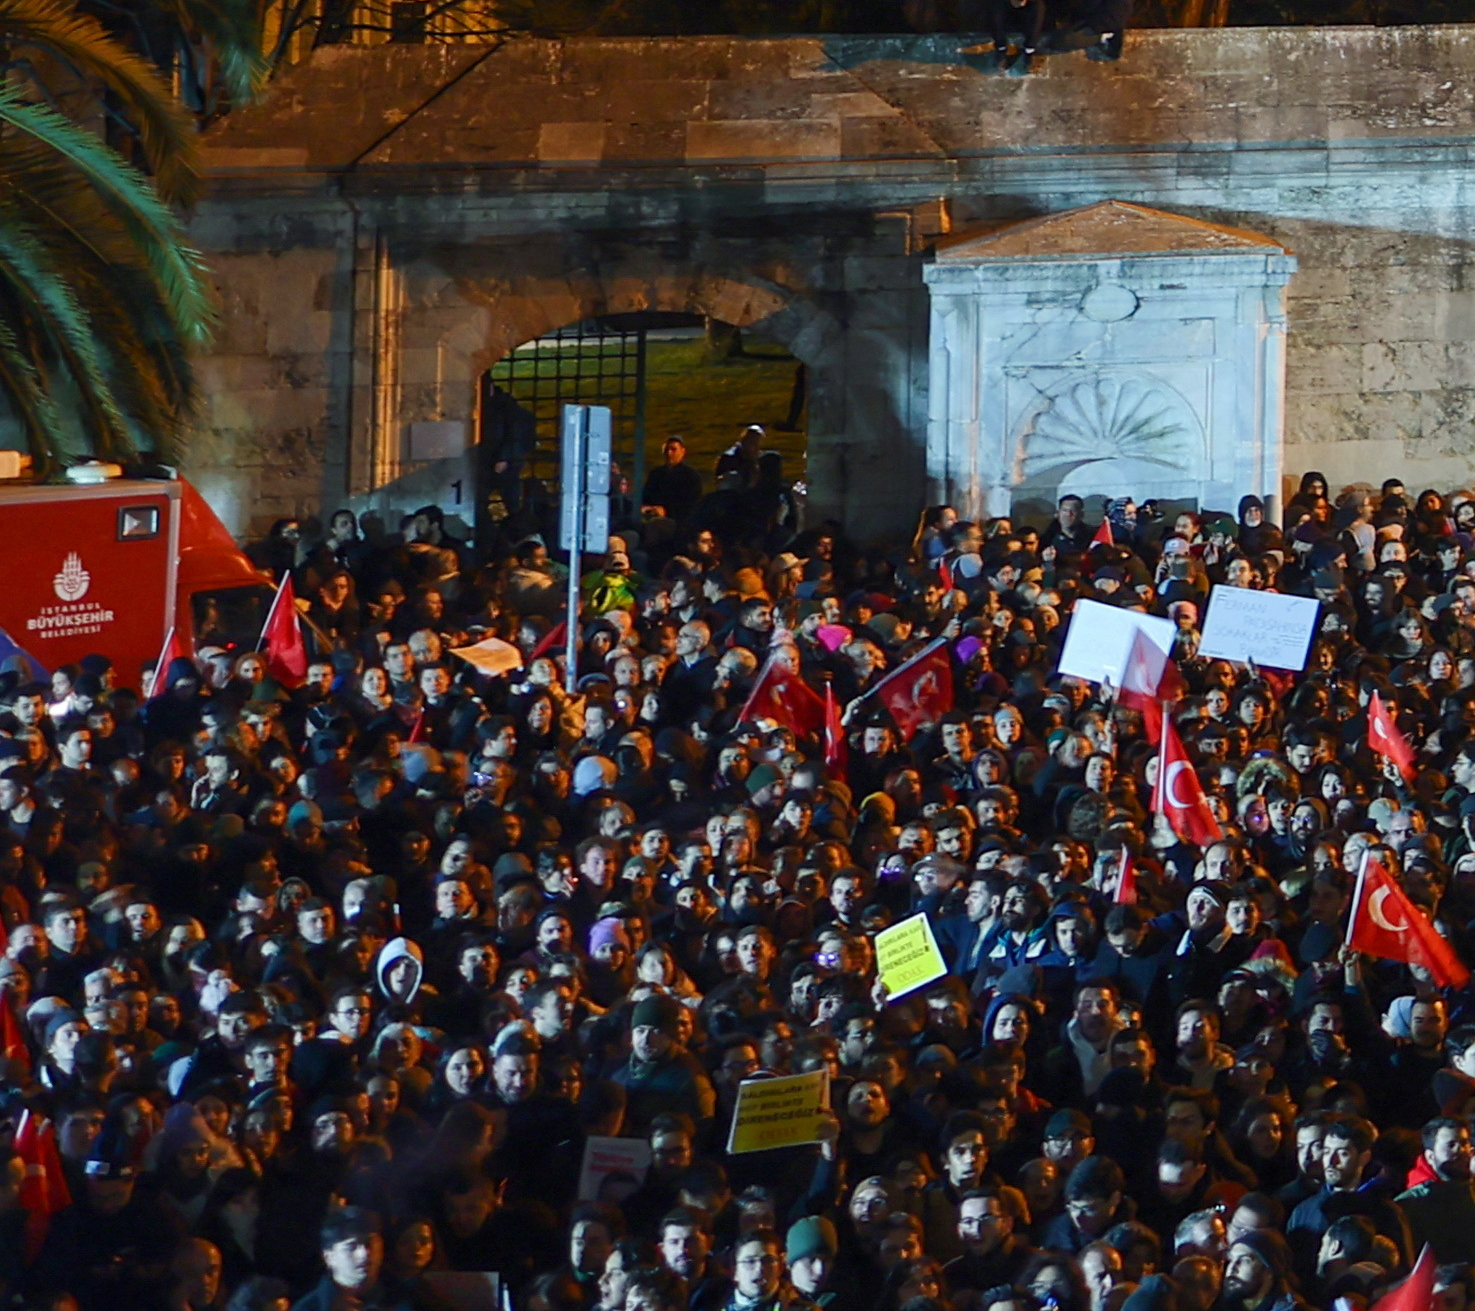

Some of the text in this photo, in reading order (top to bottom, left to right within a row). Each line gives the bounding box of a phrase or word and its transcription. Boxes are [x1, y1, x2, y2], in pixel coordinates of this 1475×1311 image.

[450, 479, 462, 505] 1
[40, 601, 101, 615] İSTANBUL
[40, 623, 102, 639] BELEDİYESİ
